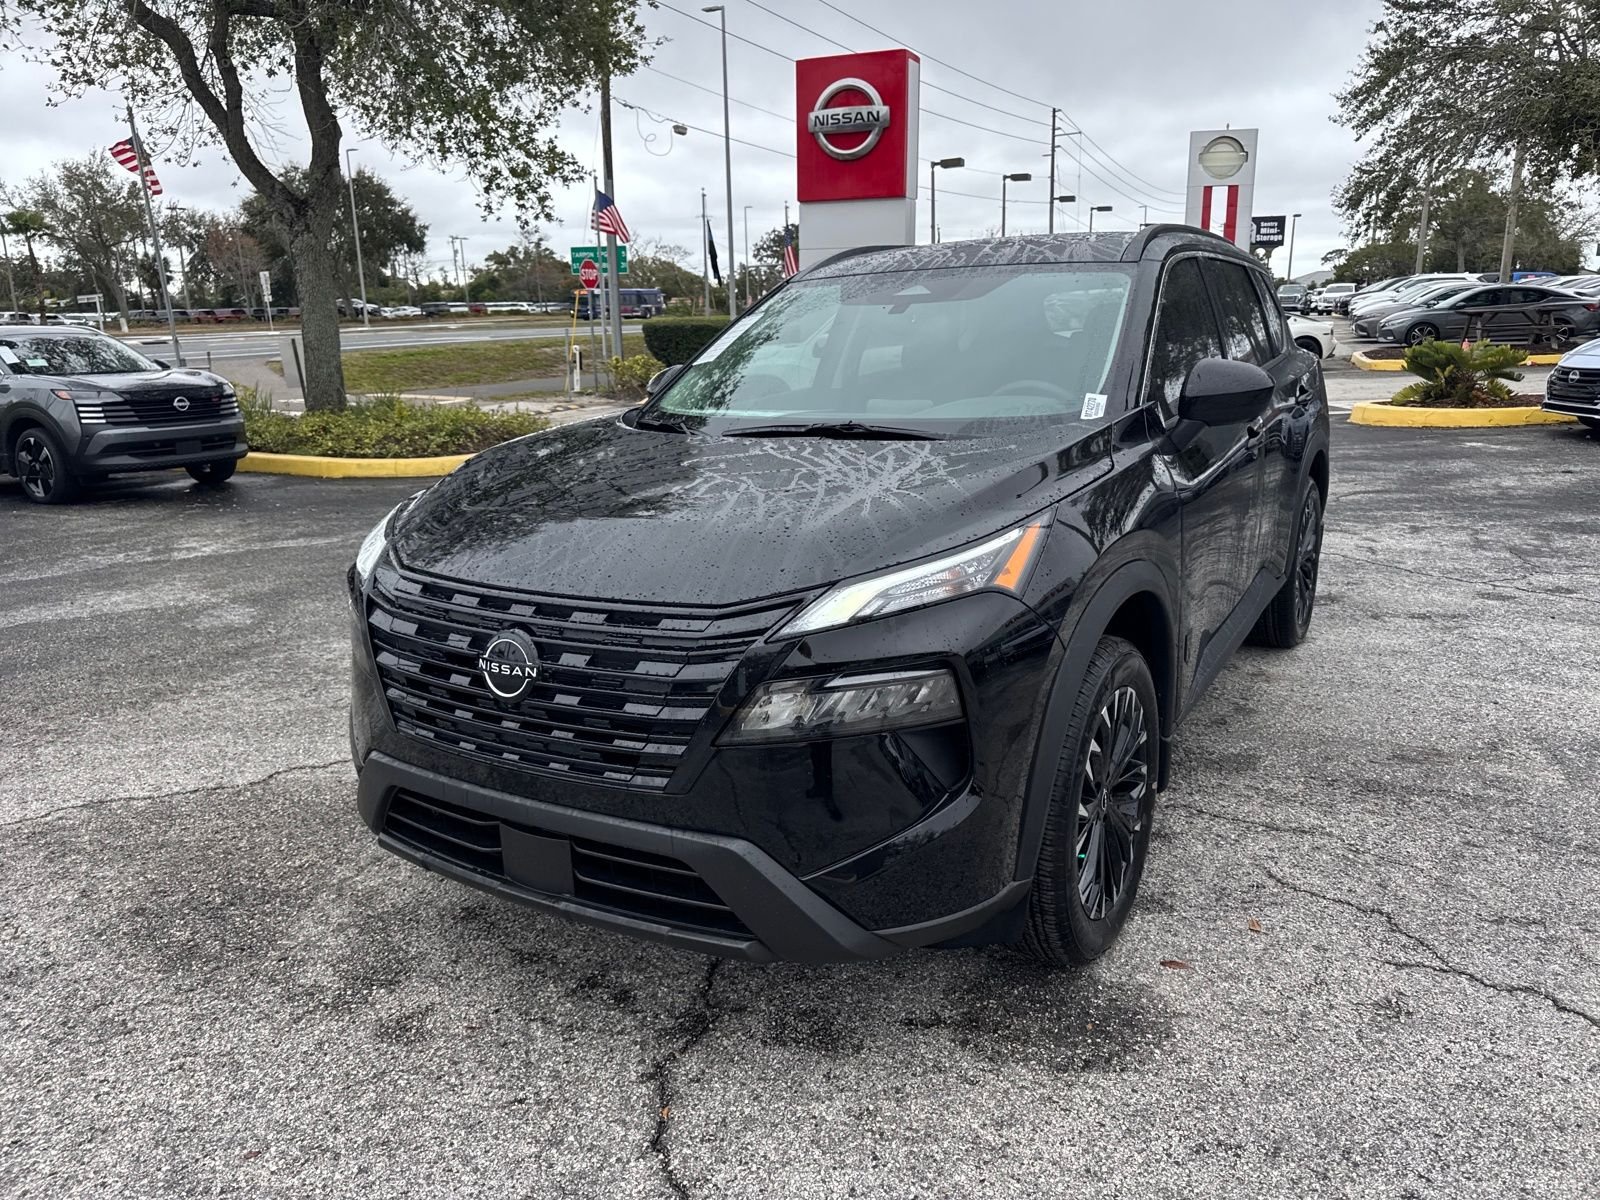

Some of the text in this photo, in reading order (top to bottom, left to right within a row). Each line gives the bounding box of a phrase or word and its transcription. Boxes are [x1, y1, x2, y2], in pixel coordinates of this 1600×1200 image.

[814, 110, 880, 127] NISSAN
[581, 269, 598, 280] STOP
[479, 658, 536, 677] NISSAN
